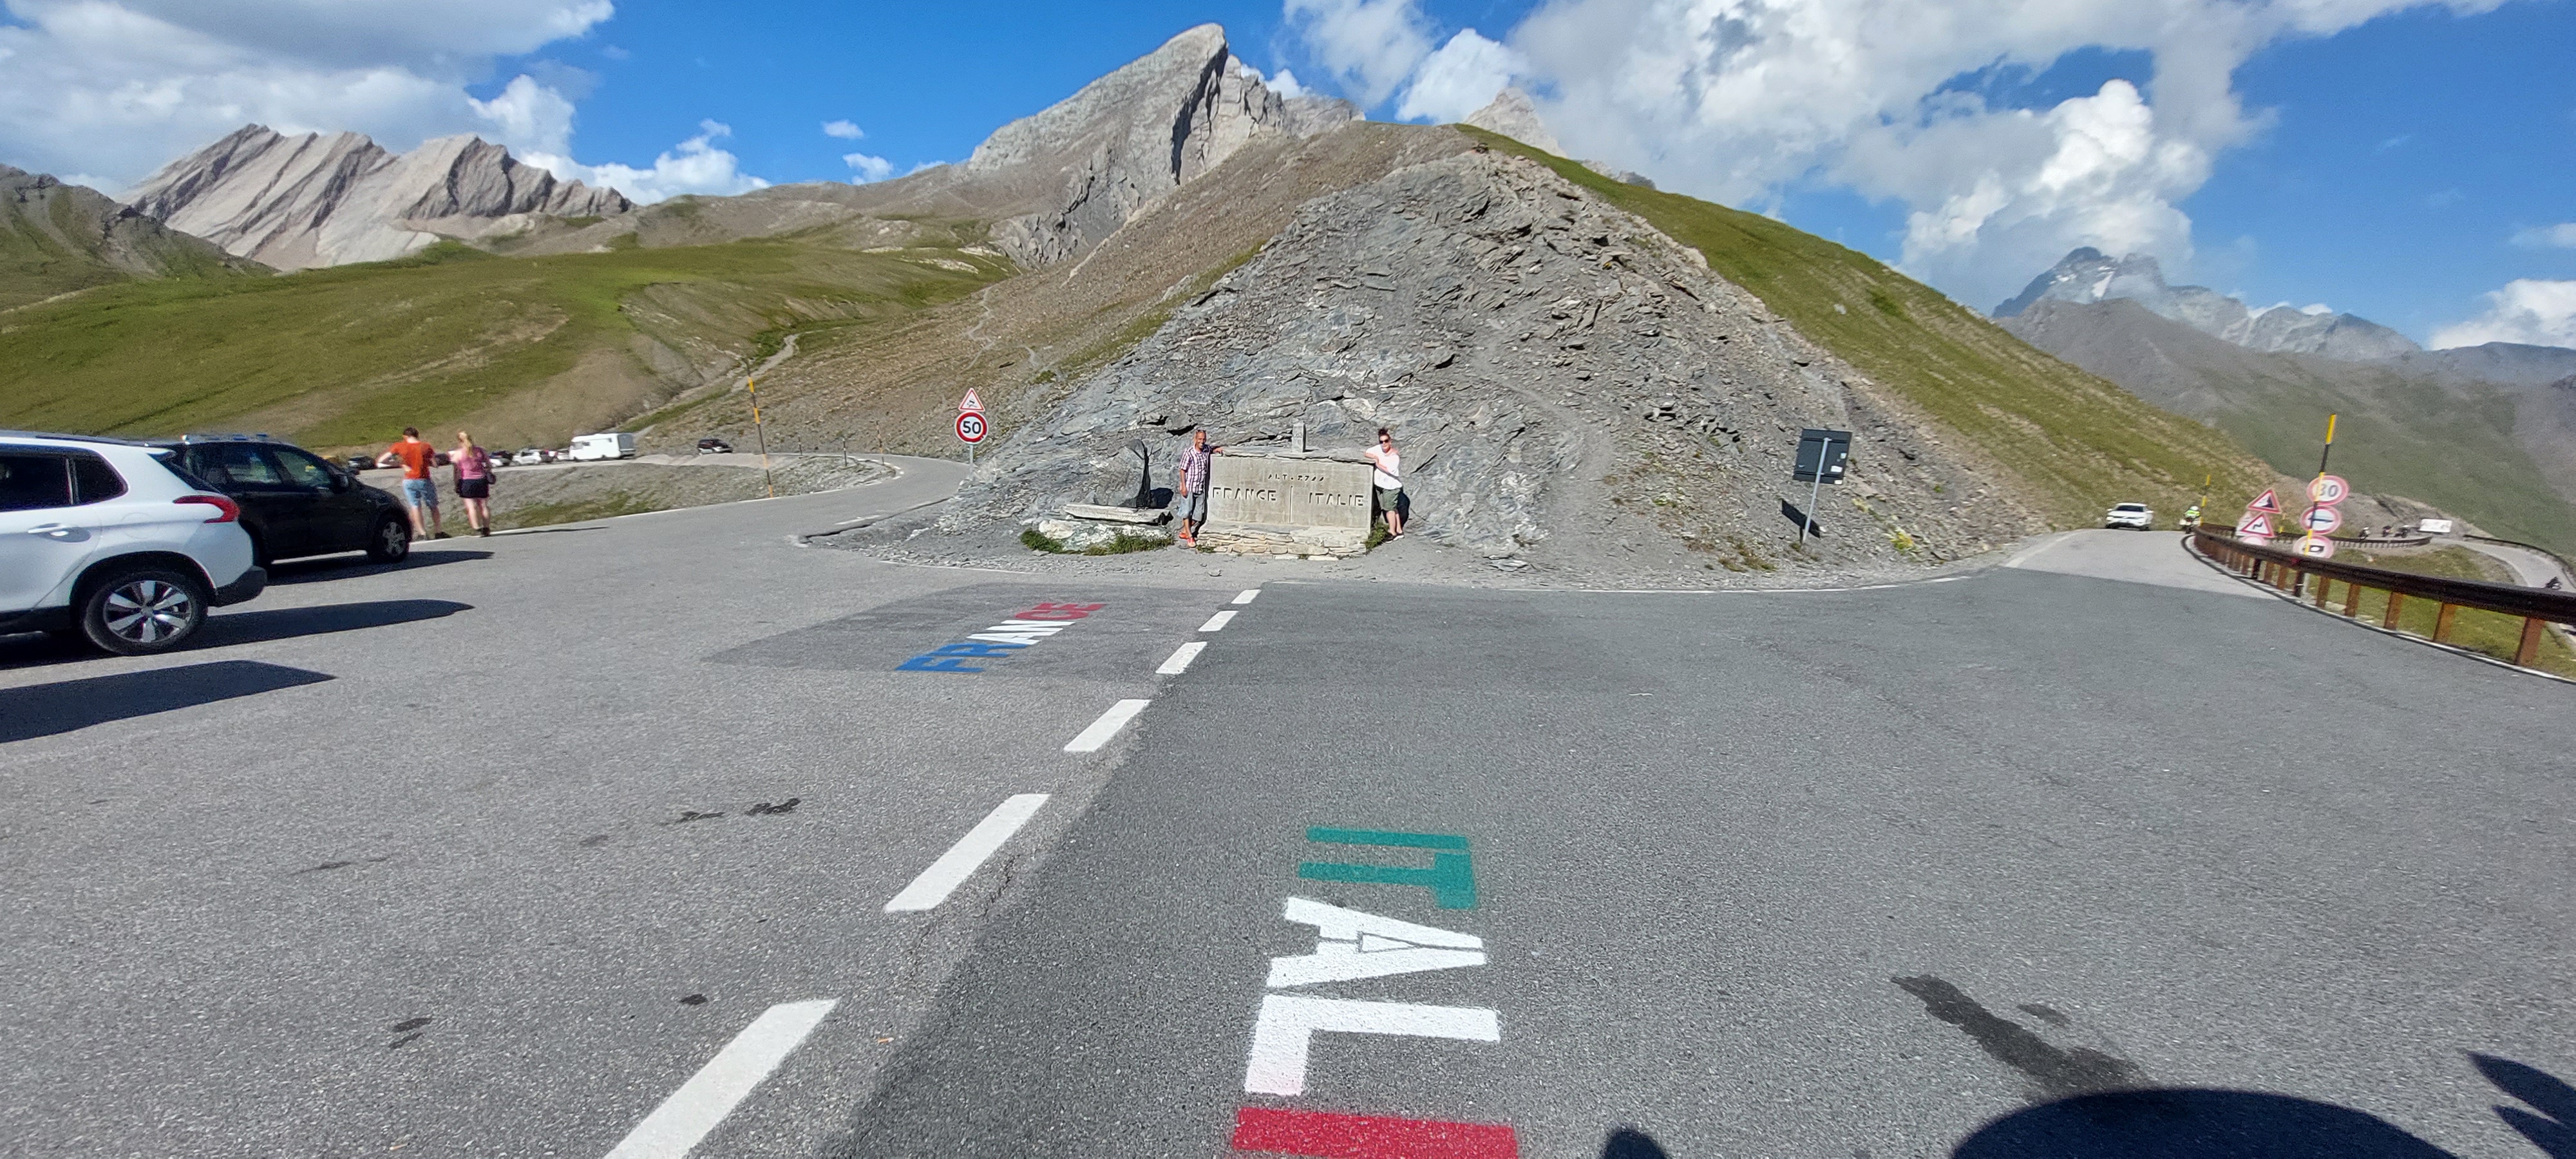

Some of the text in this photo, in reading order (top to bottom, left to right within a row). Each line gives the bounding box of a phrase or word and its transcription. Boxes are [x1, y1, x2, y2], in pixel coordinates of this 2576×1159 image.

[963, 420, 981, 434] 50
[1212, 487, 1276, 501] FRANCE
[2317, 484, 2338, 498] 30
[1308, 492, 1364, 506] ITALIE
[895, 603, 1107, 673] FRANCE
